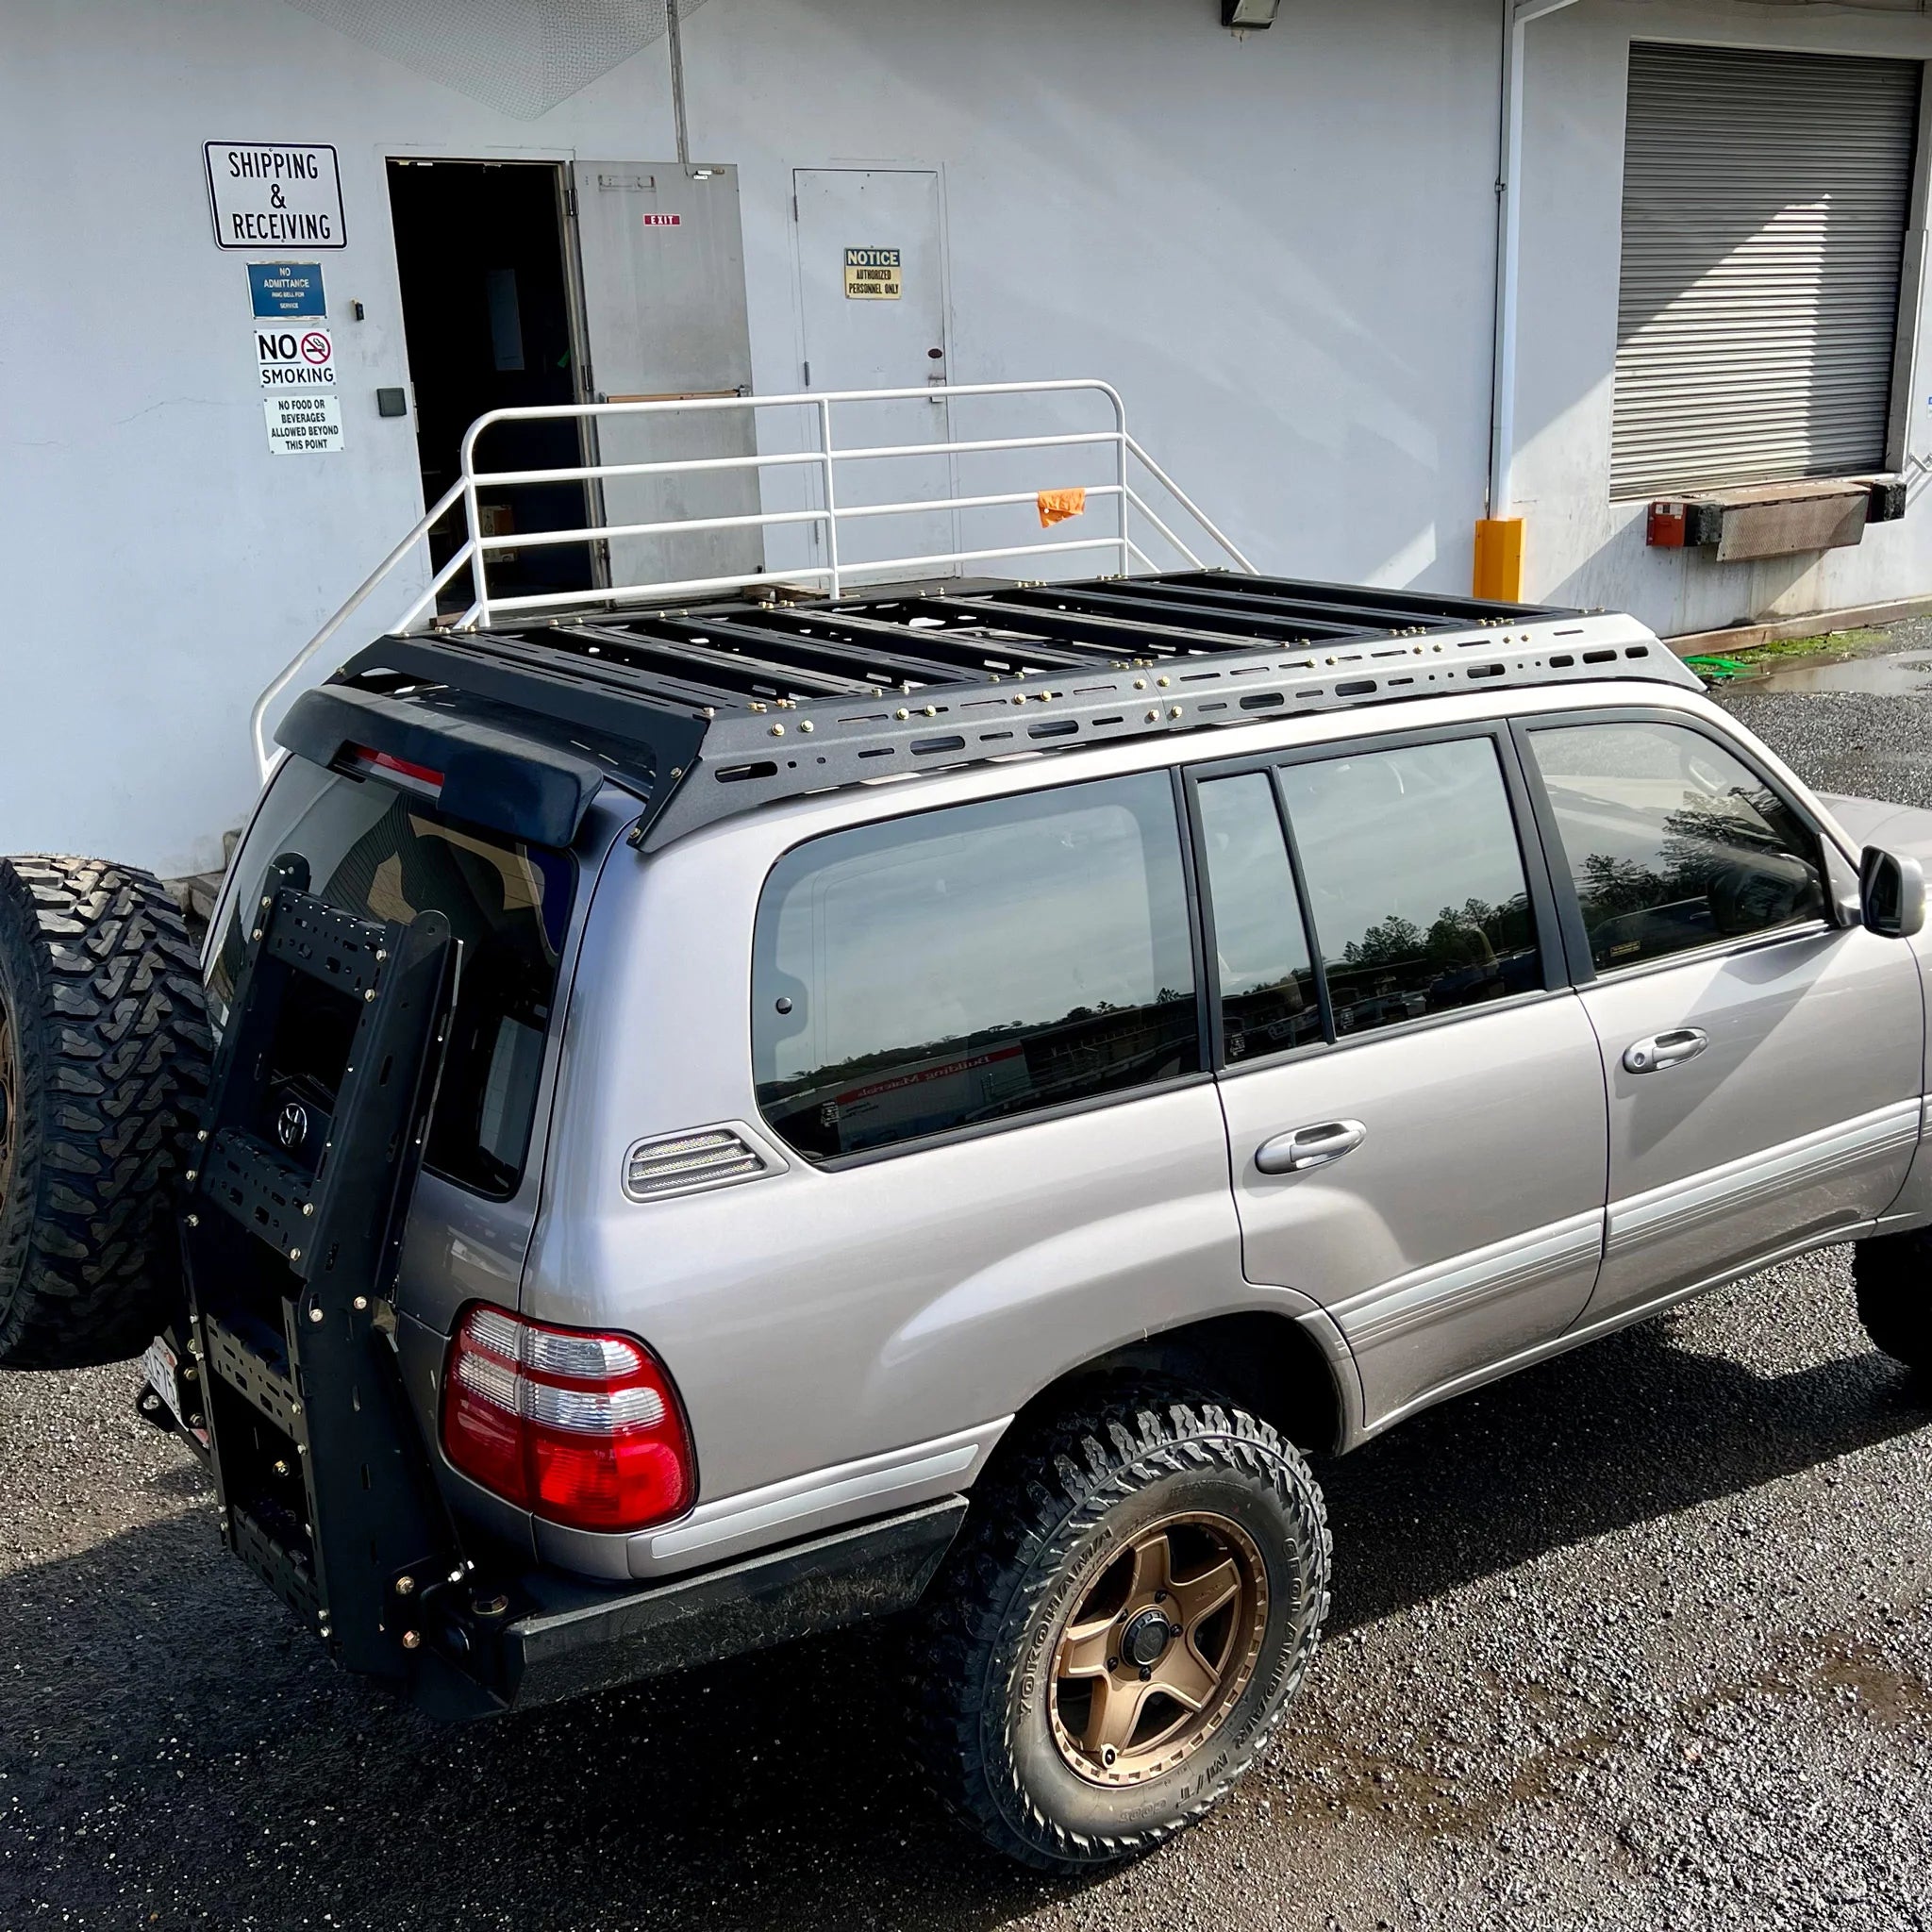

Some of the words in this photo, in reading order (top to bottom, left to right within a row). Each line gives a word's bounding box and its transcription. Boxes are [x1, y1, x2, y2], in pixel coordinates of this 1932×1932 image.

[228, 151, 319, 179] SHIPPING
[270, 183, 287, 209] &
[650, 215, 675, 225] EXIT
[232, 213, 331, 240] RECEIVING
[847, 250, 899, 265] NOTICE
[279, 267, 291, 276] NO
[857, 269, 891, 280] AUTHORIZED
[264, 278, 310, 289] ADMITTANCE
[849, 282, 883, 294] PERSONNEL
[884, 283, 899, 294] ONLY
[258, 334, 298, 360] NO
[261, 367, 335, 385] SMOKING
[278, 400, 290, 410] NO
[291, 399, 312, 410] FOOD
[313, 399, 325, 409] OR
[281, 412, 326, 424] BEVERAGES
[272, 426, 307, 438] ALLOWED
[308, 425, 339, 436] BEYOND
[285, 440, 304, 451] THIS
[305, 439, 327, 449] POINT
[1018, 1524, 1113, 1716] YOKOHAMA
